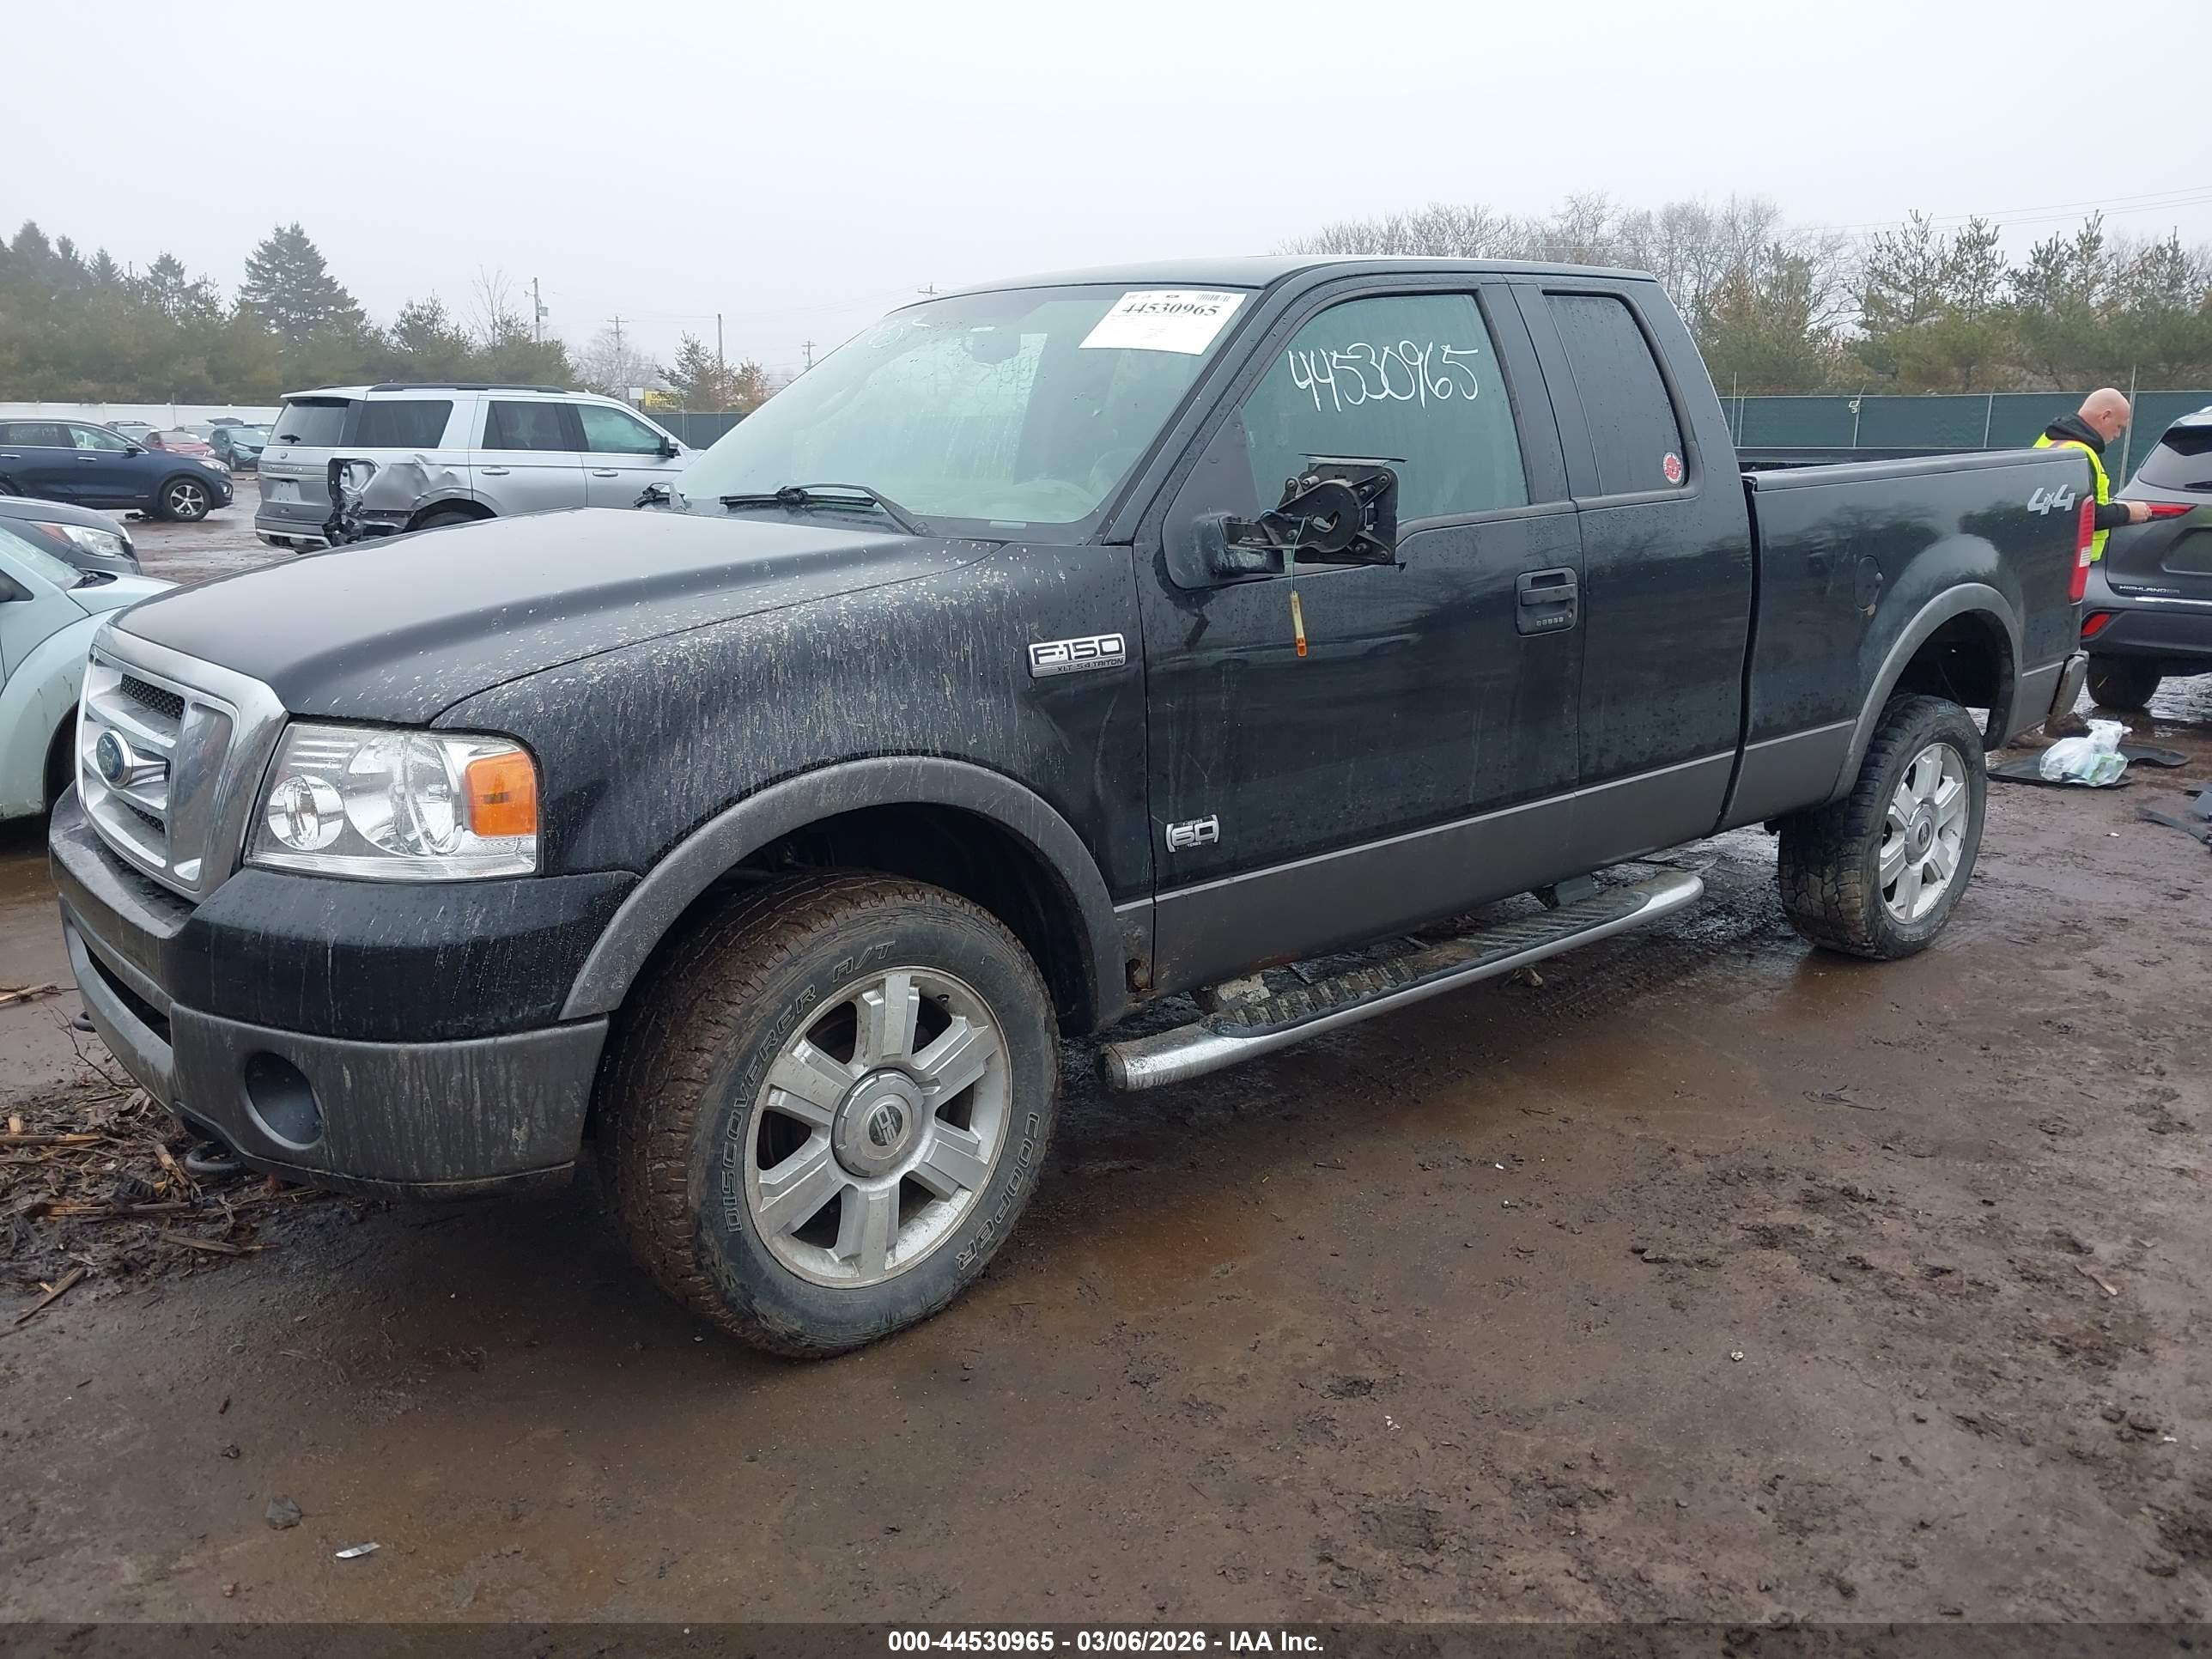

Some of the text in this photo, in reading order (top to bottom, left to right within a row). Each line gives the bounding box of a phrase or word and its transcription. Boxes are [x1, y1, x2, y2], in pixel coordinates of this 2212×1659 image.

[1122, 303, 1221, 316] 44530965
[1288, 340, 1479, 412] 44530965
[1033, 637, 1123, 665] F-150
[1092, 658, 1123, 667] TRITON
[722, 941, 895, 1233] DISCOVERER A/T
[955, 1112, 1040, 1271] COOPER
